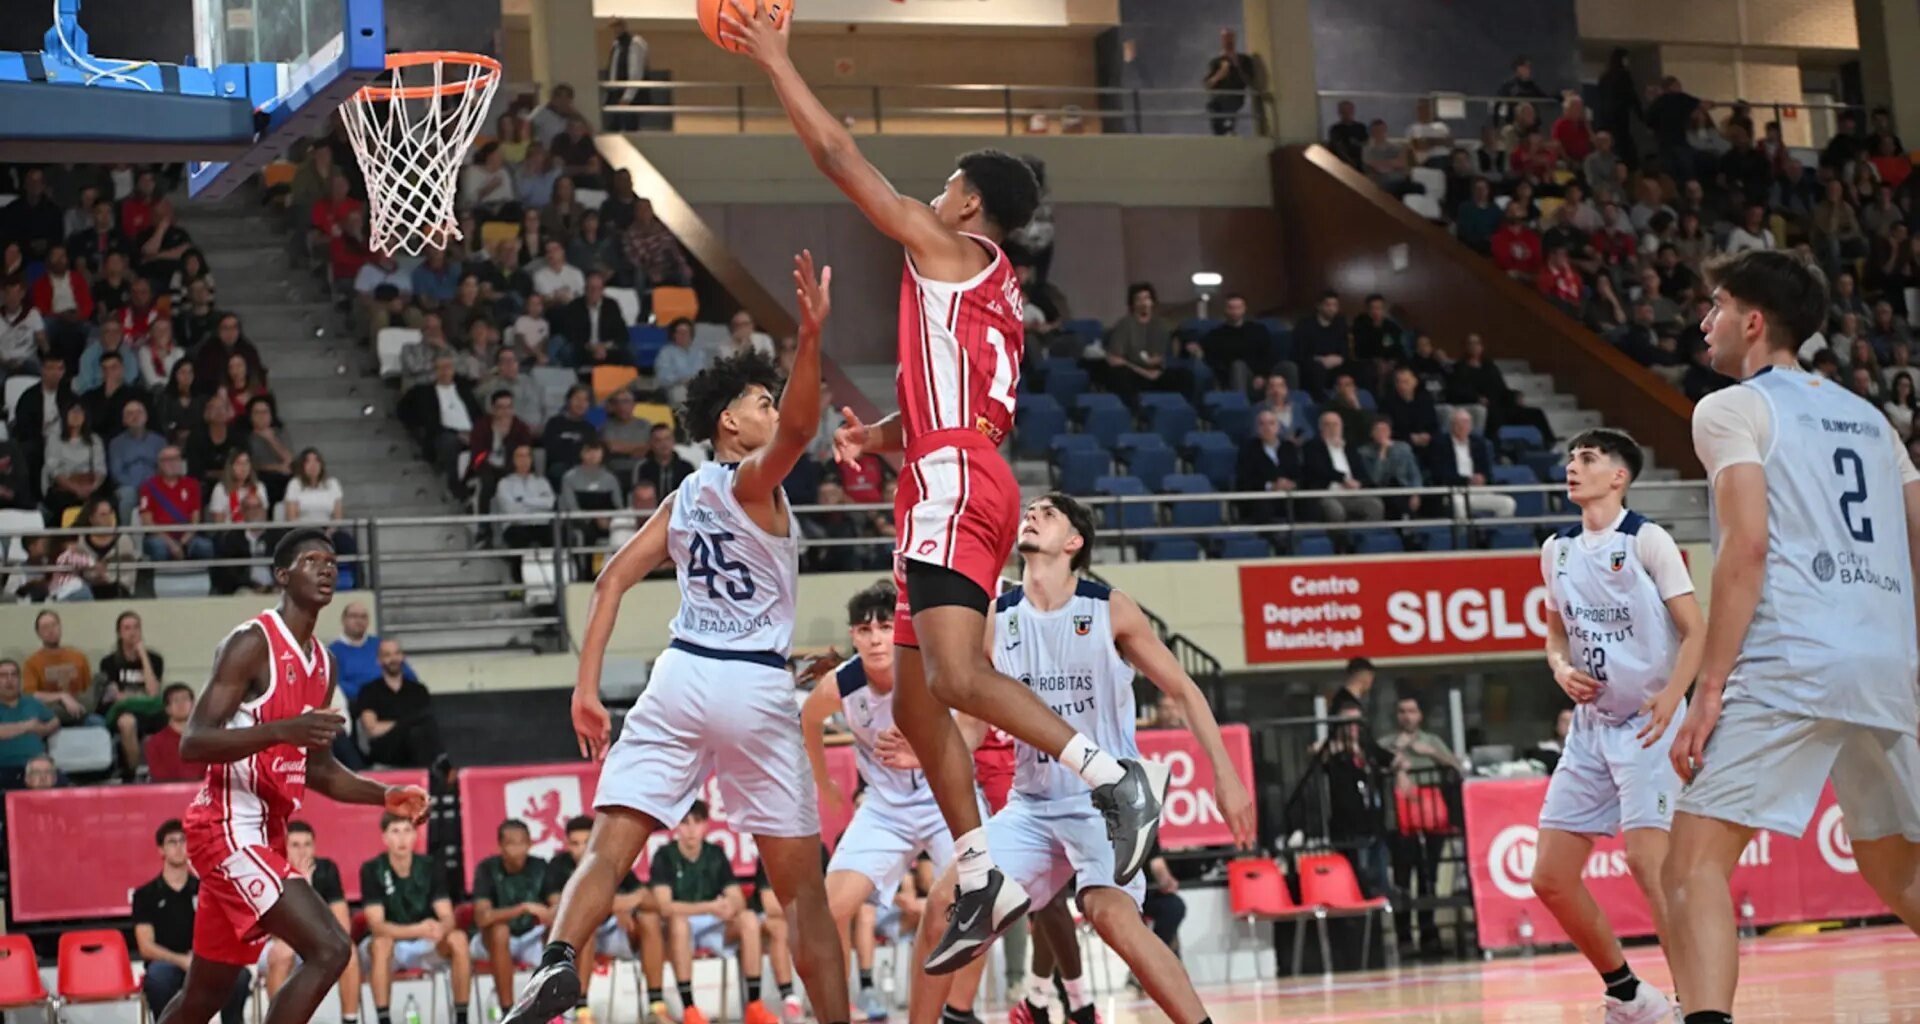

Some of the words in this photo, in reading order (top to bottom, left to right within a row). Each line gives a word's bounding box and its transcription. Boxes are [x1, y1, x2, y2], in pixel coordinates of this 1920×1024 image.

[1832, 447, 1874, 543] 2
[687, 531, 756, 601] 45
[1290, 575, 1361, 597] Centro
[698, 613, 773, 634] BADALONA
[1263, 601, 1363, 627] Deportivo
[1265, 626, 1364, 650] Municipal
